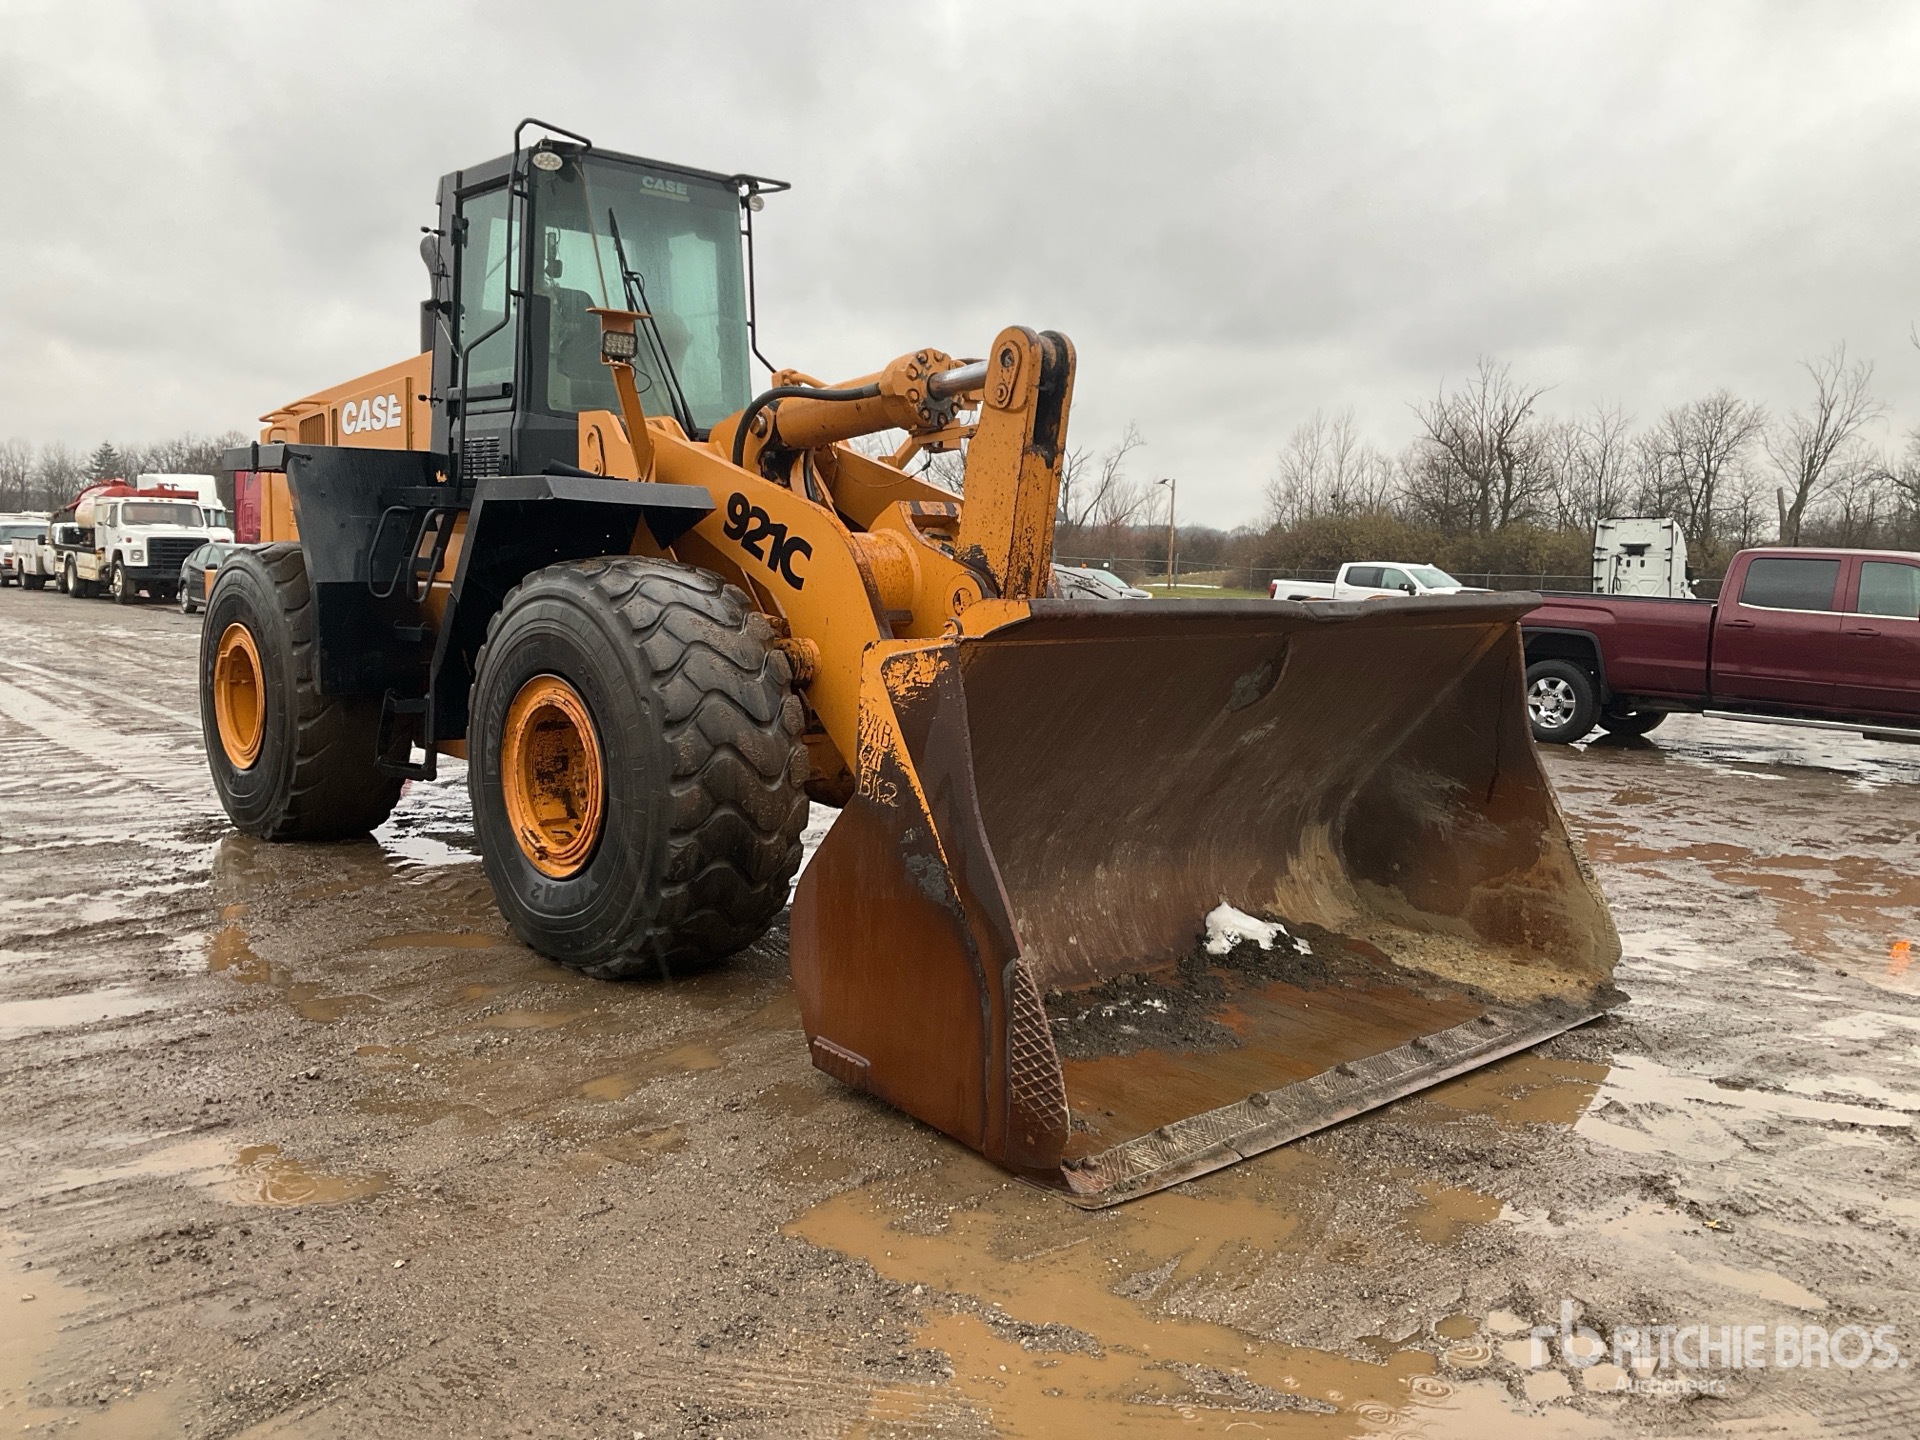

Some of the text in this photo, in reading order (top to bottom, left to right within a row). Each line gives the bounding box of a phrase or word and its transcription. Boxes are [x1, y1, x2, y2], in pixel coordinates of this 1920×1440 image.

[642, 176, 688, 195] CASE
[341, 394, 402, 435] CASE
[723, 492, 813, 591] 921C
